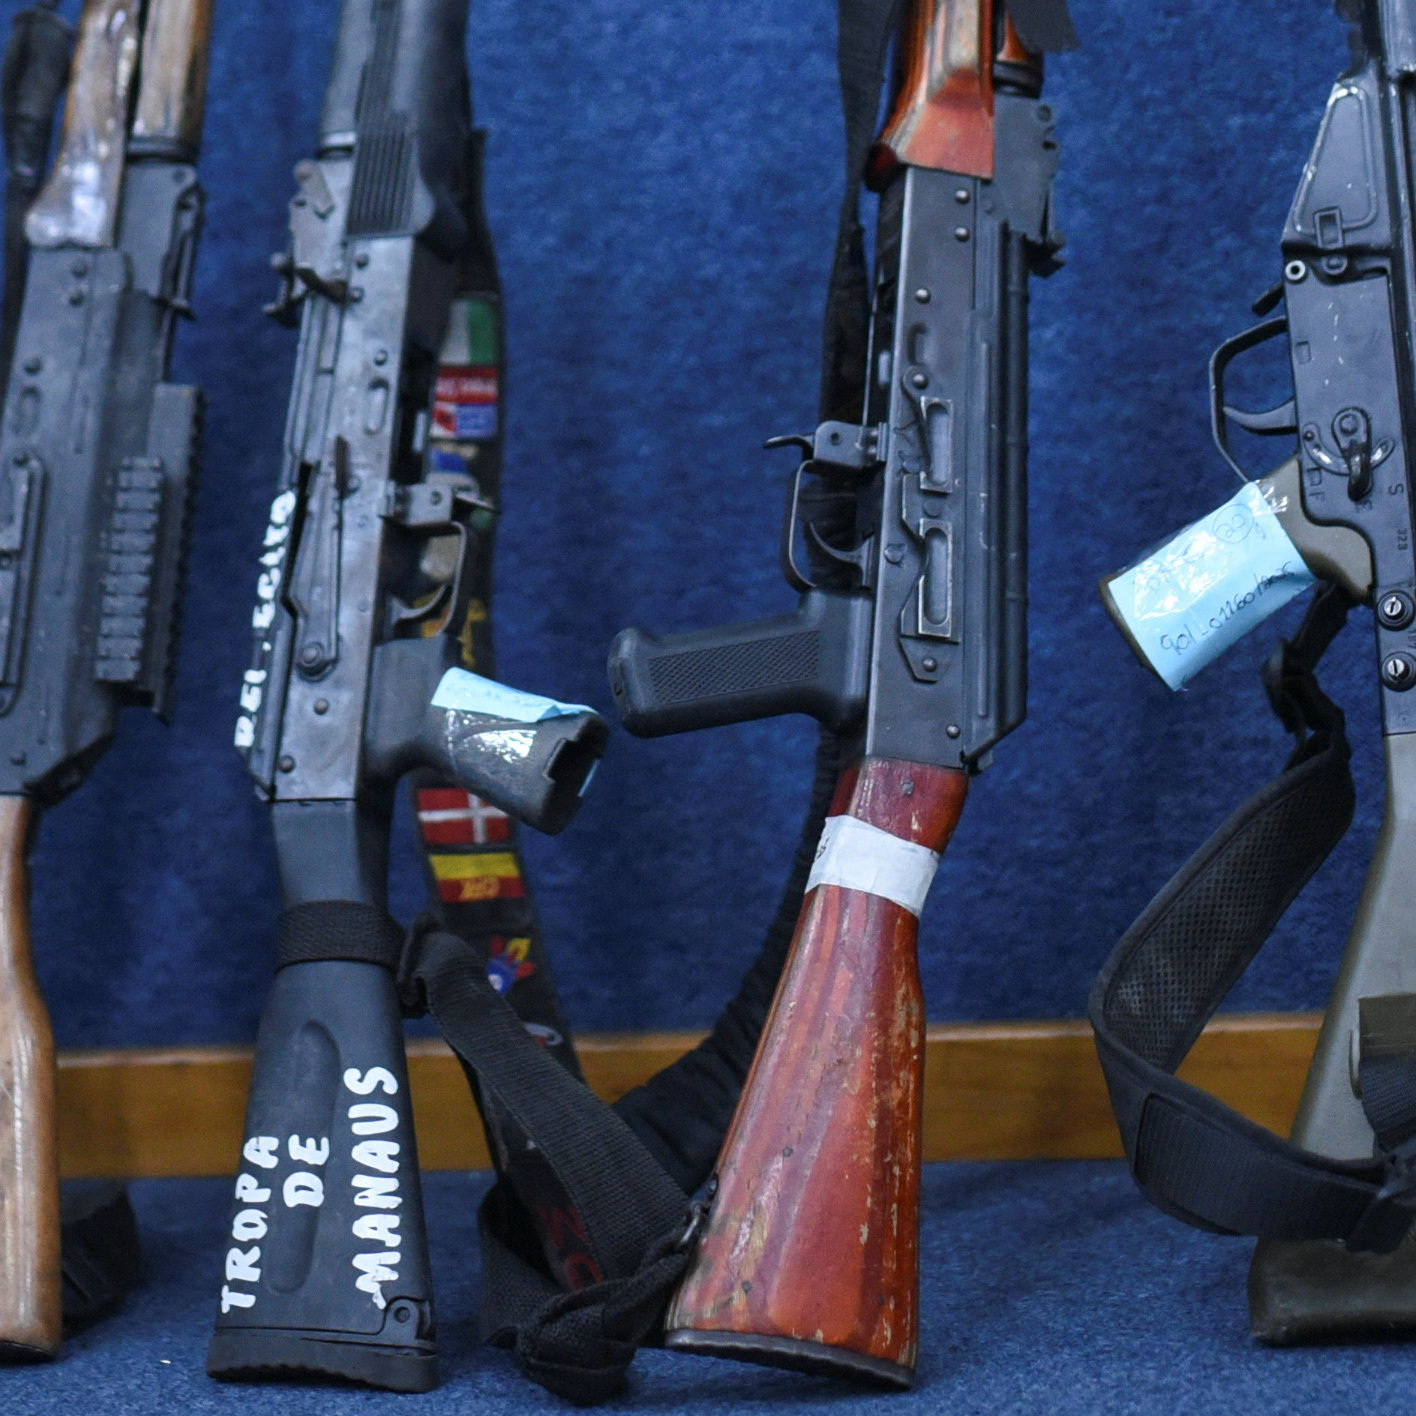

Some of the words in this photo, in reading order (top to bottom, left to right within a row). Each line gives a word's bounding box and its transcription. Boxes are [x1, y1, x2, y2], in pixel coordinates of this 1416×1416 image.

[1388, 483, 1404, 496] S
[221, 1136, 280, 1314] TROPA
[283, 1134, 330, 1208] DE
[342, 1066, 403, 1310] MANAUS
